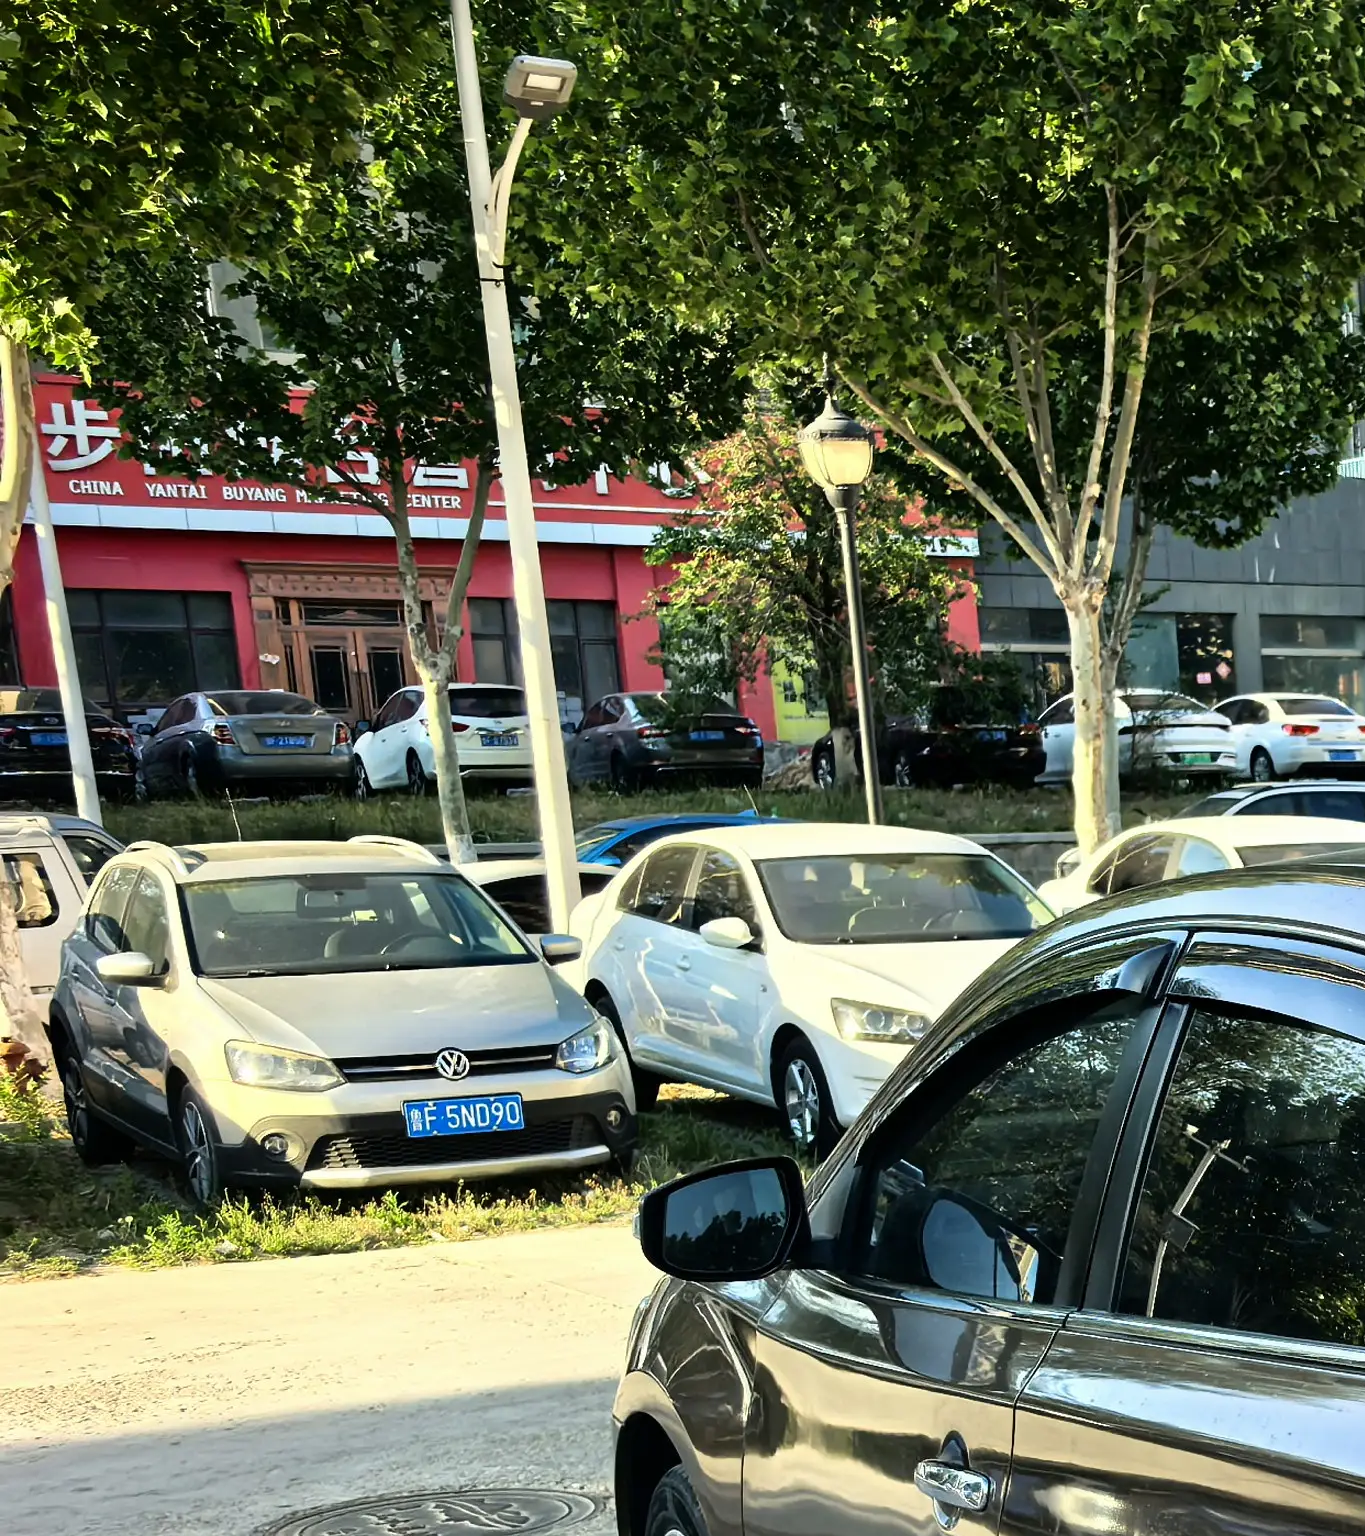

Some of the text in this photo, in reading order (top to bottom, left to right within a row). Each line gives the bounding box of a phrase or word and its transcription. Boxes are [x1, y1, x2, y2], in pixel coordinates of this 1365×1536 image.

[69, 479, 125, 496] CHINA
[146, 482, 208, 499] YANTAI
[222, 486, 287, 502] BUYANG
